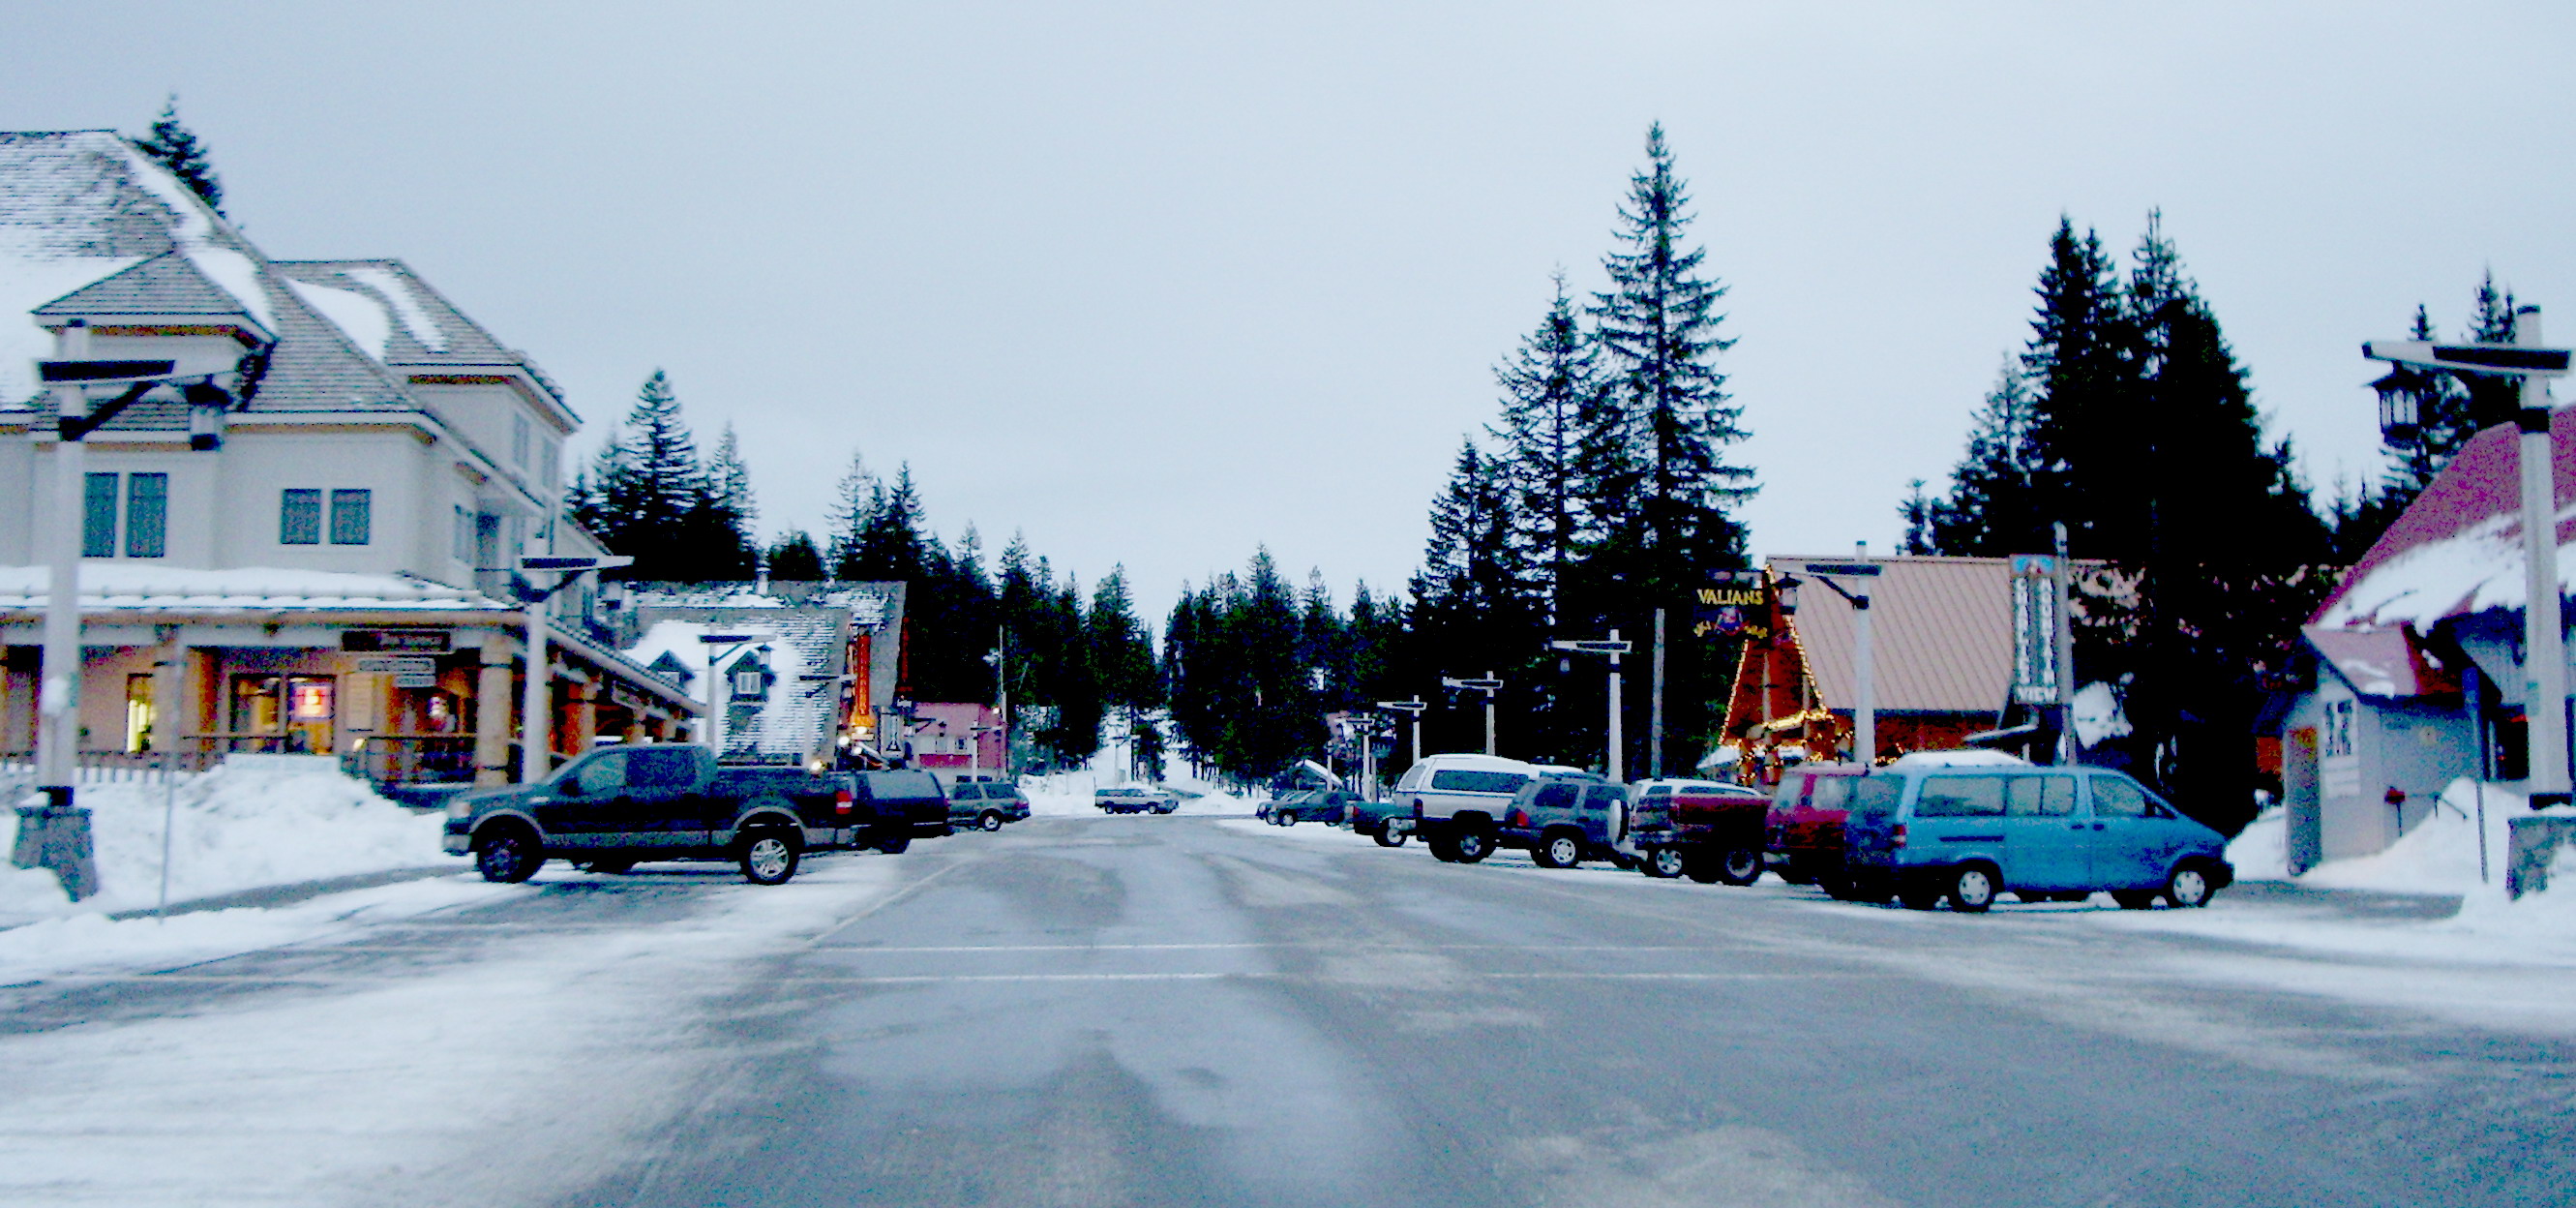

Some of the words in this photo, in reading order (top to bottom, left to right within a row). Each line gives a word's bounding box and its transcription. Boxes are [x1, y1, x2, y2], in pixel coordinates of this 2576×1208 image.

[1696, 589, 1764, 605] VALIANS
[2040, 578, 2055, 683] MOUNTAIN
[2018, 686, 2057, 702] VIEW
